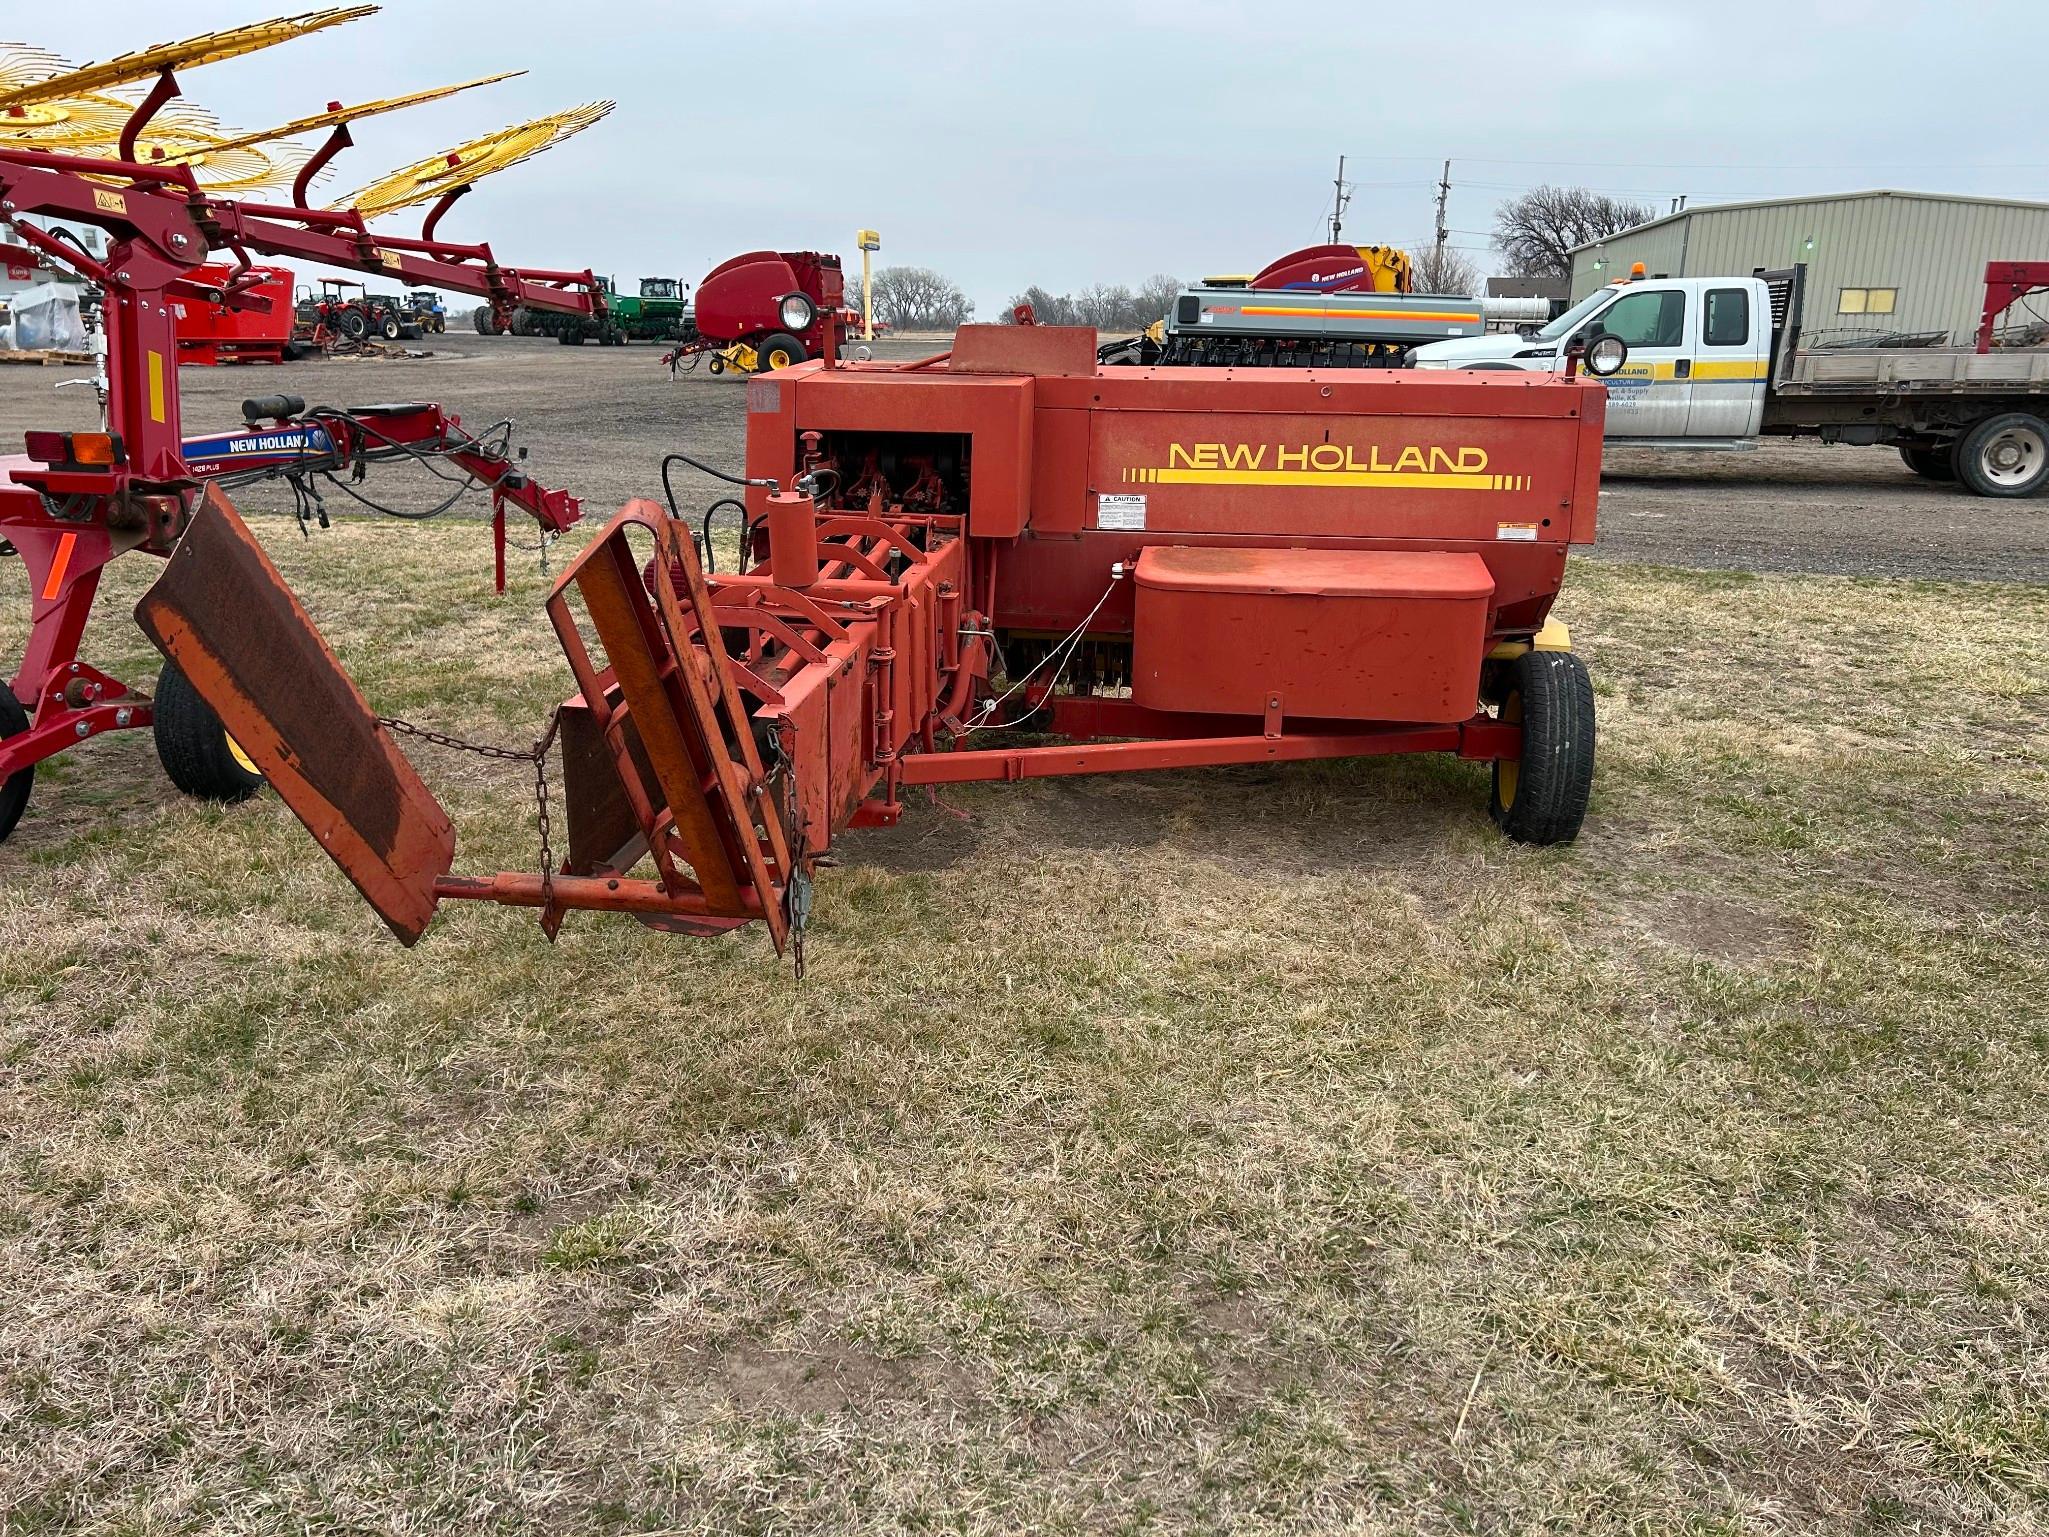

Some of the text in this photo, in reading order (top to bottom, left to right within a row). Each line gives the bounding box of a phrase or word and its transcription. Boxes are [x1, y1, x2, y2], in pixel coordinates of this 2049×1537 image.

[1321, 267, 1364, 282] NEW HOLLAND
[1627, 387, 1649, 396] Supply
[229, 434, 309, 453] NEW HOLLAND
[1169, 443, 1489, 474] NEW HOLLAND
[206, 463, 220, 471] PLUS
